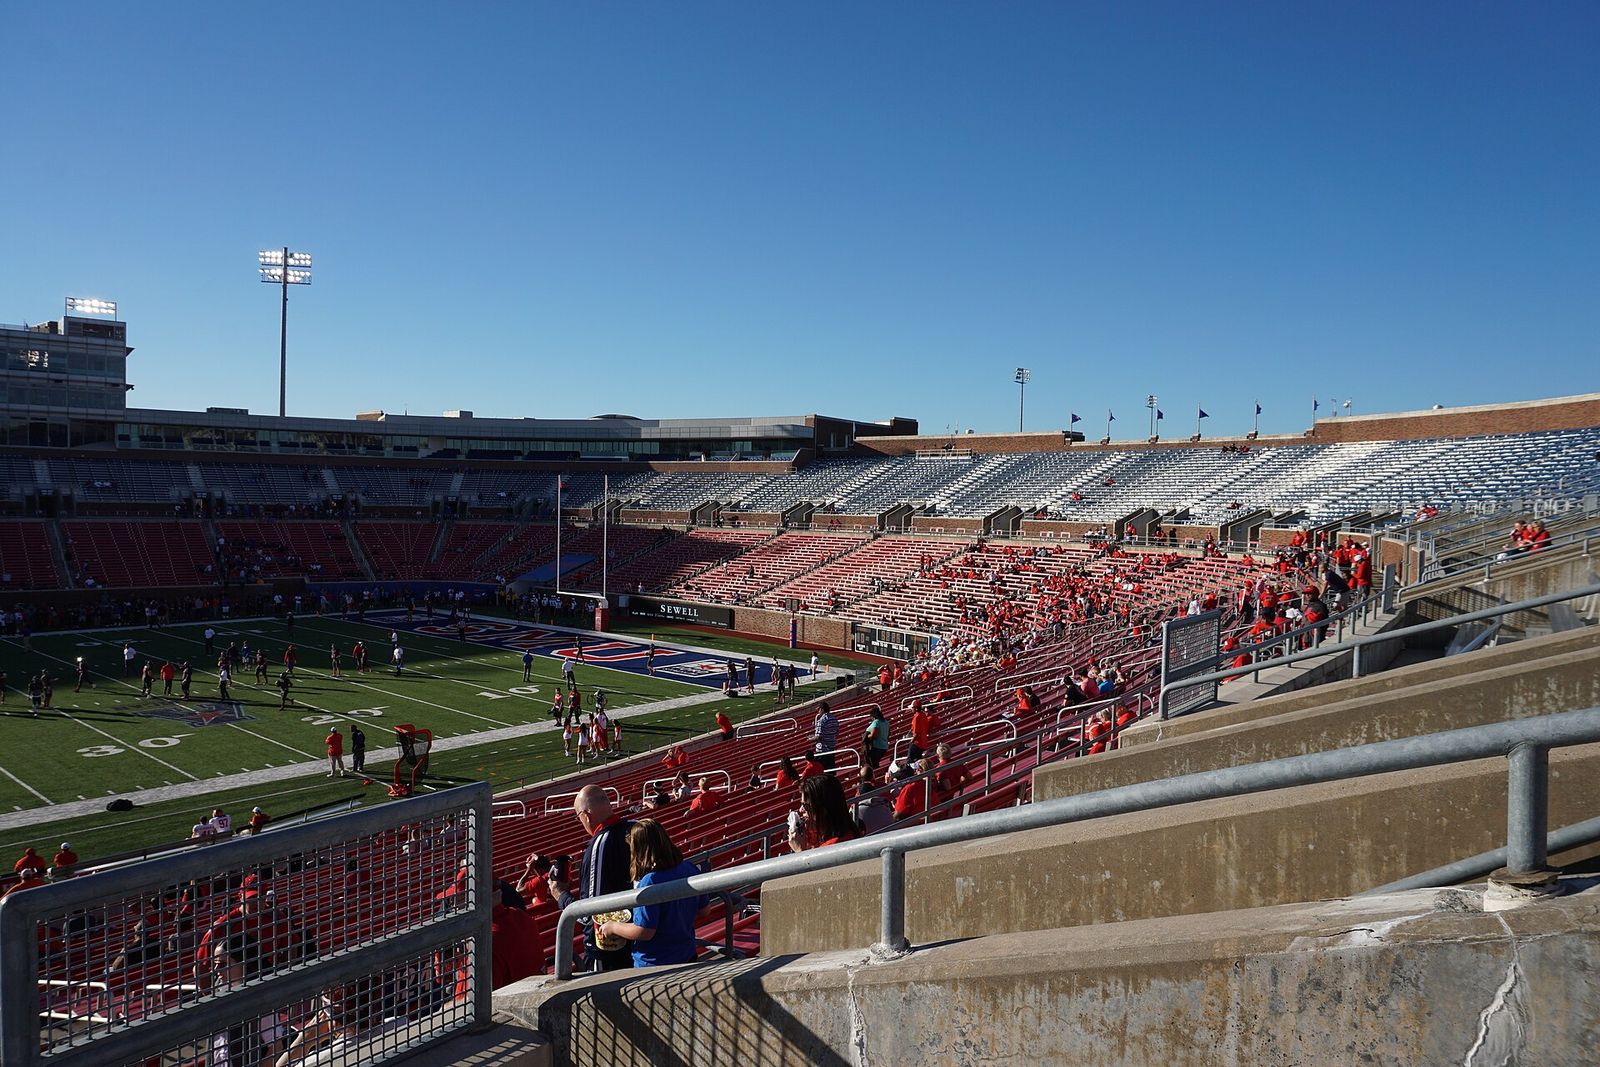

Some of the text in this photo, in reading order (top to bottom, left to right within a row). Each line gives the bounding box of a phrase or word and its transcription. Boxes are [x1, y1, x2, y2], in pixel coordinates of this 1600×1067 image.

[660, 604, 699, 617] SEWELL
[475, 687, 540, 700] 10
[75, 737, 181, 757] 30
[218, 818, 229, 828] 97
